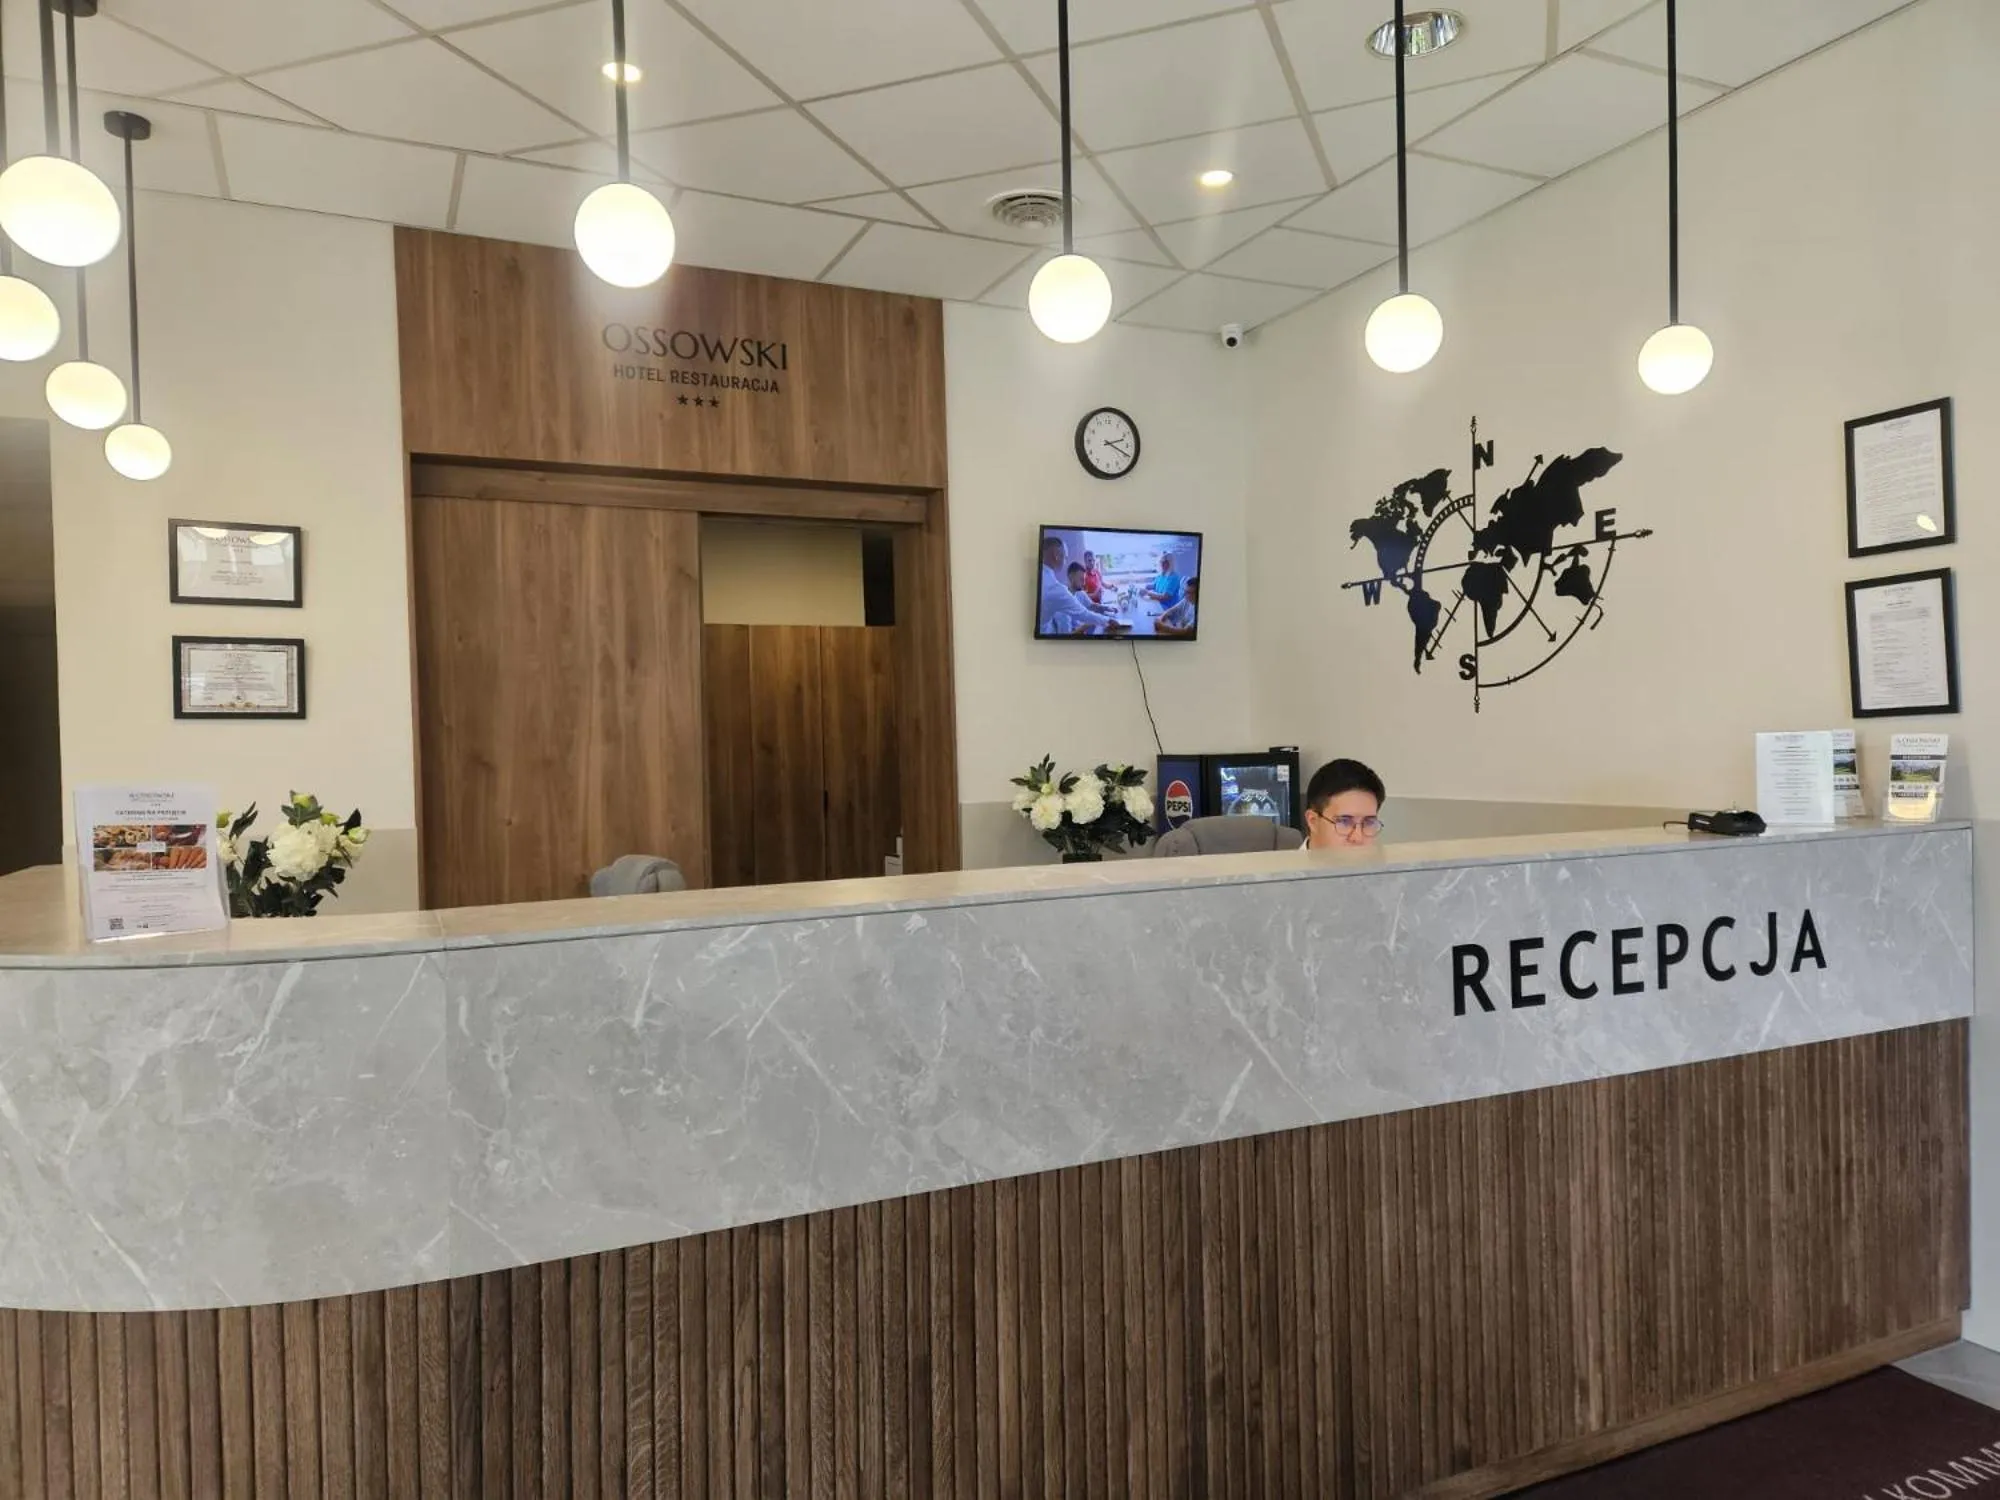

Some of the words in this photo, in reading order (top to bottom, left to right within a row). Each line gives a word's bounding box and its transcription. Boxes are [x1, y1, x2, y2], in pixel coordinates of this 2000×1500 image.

[602, 322, 788, 371] OSSOWSKI
[613, 363, 666, 383] HOTEL
[670, 370, 780, 393] RESTAURACJA
[1474, 439, 1495, 471] N
[1595, 507, 1617, 542] E
[1361, 579, 1382, 607] W
[1458, 653, 1477, 681] S
[1166, 799, 1192, 813] PEPSI
[1451, 908, 1828, 1017] RECEPCJA
